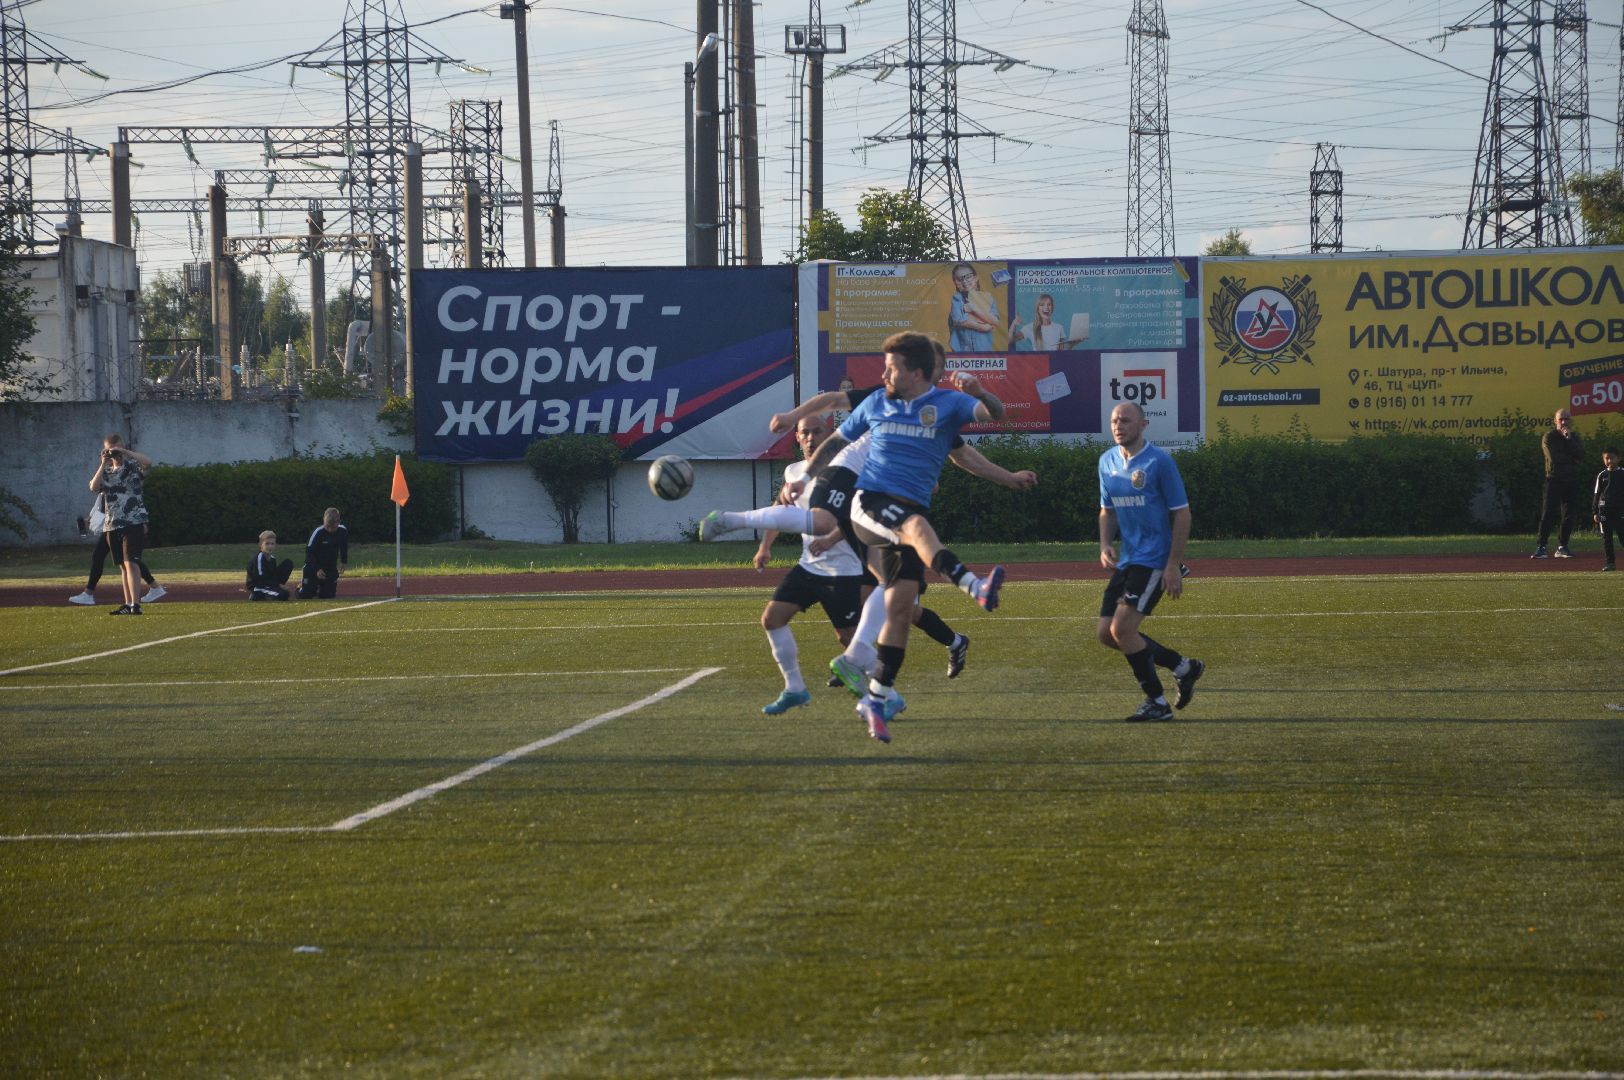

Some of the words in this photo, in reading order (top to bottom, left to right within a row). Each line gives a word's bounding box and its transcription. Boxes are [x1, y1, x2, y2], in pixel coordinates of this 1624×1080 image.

[1018, 268, 1106, 278] ПРОФЕССИОНАЛЬНОЕ
[1107, 266, 1173, 276] КОМПЬЮТЕРНОЕ
[1018, 277, 1075, 285] ОБРАЗОВАНИЕ
[843, 289, 901, 299] программе:
[1115, 289, 1121, 297] В
[1123, 288, 1183, 298] программе:
[437, 284, 645, 343] Спорт
[661, 305, 682, 316] -
[835, 319, 913, 329] Преимущества:
[437, 345, 658, 395] норма
[944, 359, 1004, 369] ПЬЮТЕРНАЯ
[1563, 359, 1624, 378] ОБУЧЕНИЕ
[1363, 369, 1373, 377] г.
[1377, 367, 1427, 379] Шатура,
[1431, 367, 1457, 378] пр-т
[1461, 365, 1508, 377] Ильича,
[1109, 377, 1157, 405] top
[1364, 381, 1382, 392] 46,
[1387, 380, 1403, 392] ТЦ
[1407, 379, 1442, 391] «ЦУП»
[1363, 397, 1371, 408] 8
[1376, 396, 1407, 409] (916)
[1411, 396, 1425, 407] 01
[1431, 395, 1446, 407] 14
[1449, 395, 1473, 407] 777
[435, 387, 680, 437] жизни!
[827, 489, 846, 508] 18
[881, 503, 905, 522] 11
